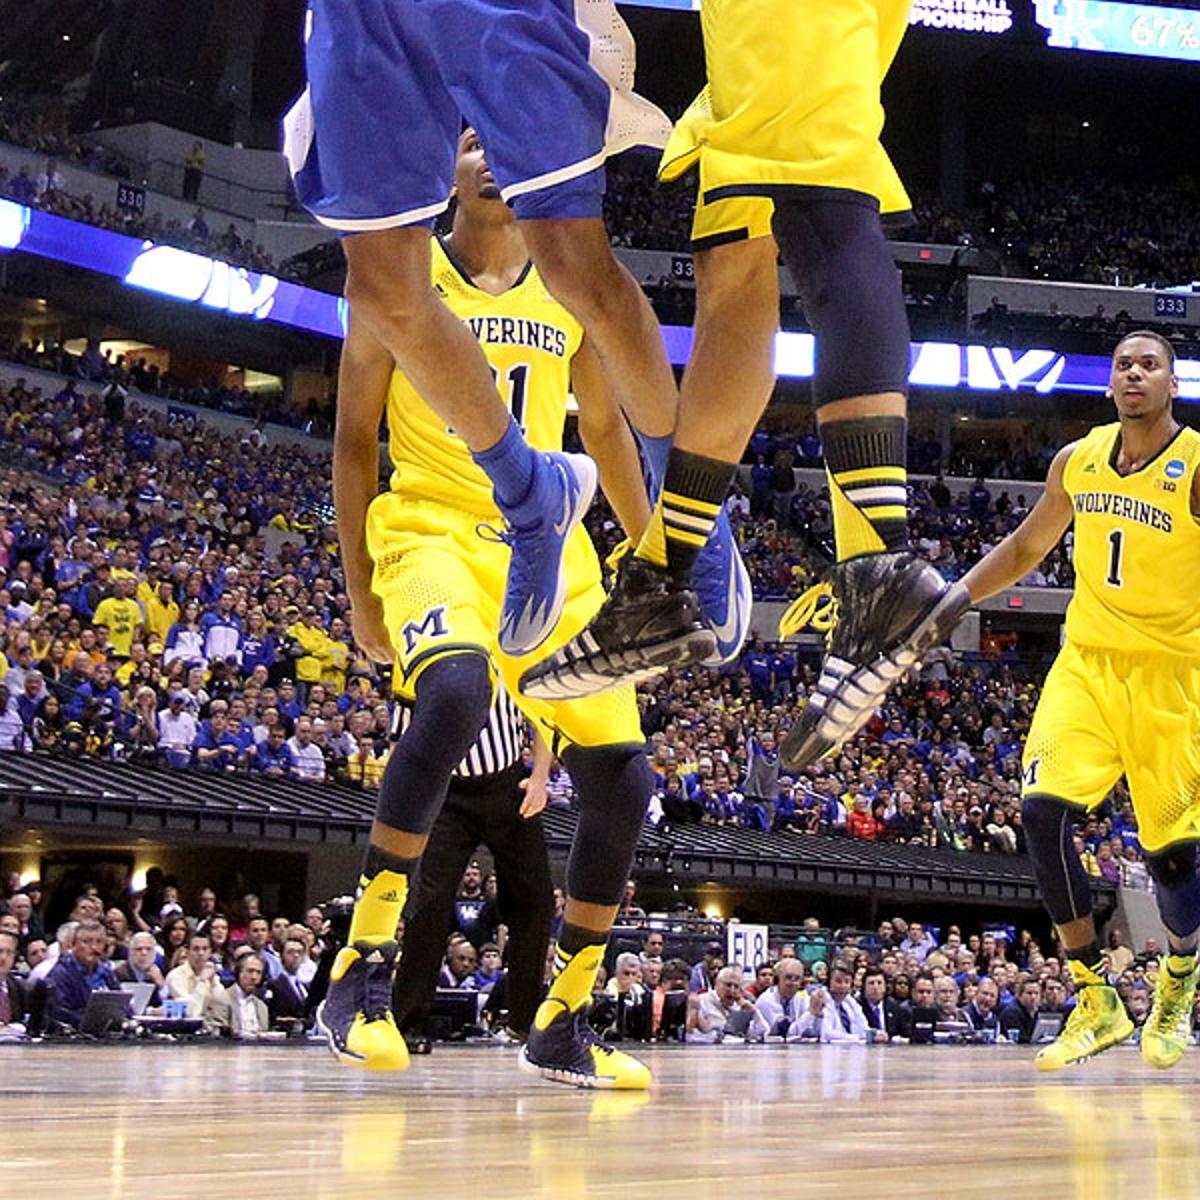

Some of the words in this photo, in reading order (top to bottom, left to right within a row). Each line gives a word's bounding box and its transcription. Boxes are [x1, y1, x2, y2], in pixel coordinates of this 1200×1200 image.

[1130, 15, 1200, 49] 67%
[119, 188, 143, 208] 330
[1157, 297, 1185, 313] 333
[1074, 493, 1173, 534] WOLVERINES
[1107, 529, 1124, 587] 1
[403, 607, 448, 655] M
